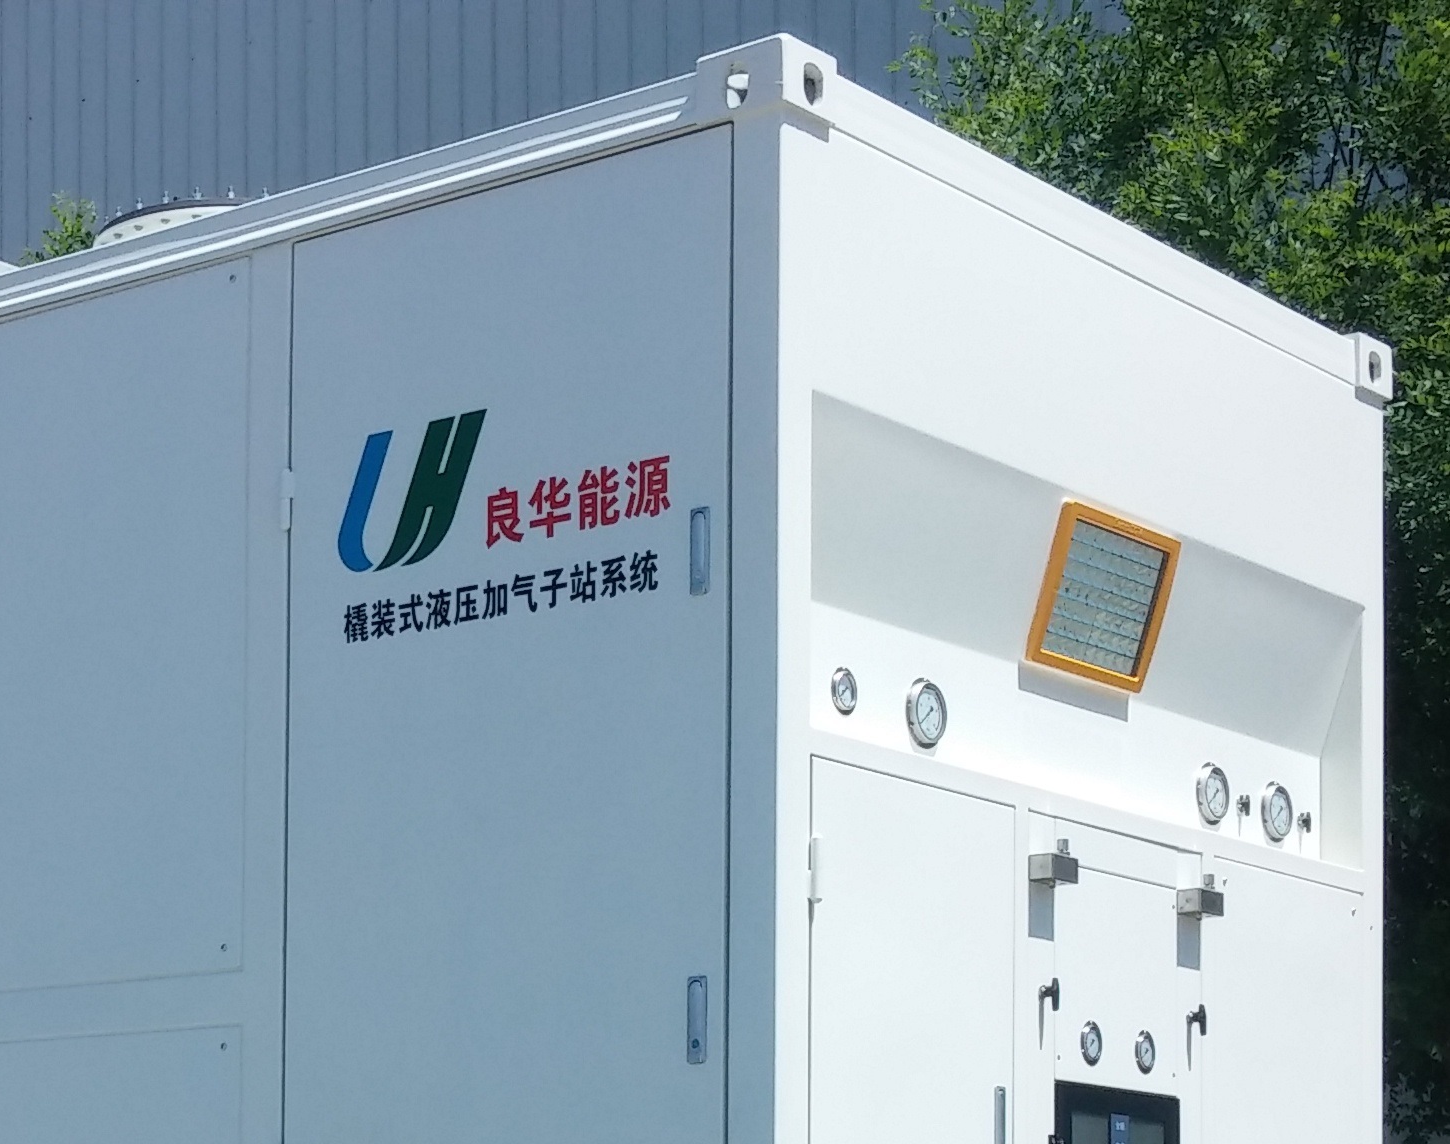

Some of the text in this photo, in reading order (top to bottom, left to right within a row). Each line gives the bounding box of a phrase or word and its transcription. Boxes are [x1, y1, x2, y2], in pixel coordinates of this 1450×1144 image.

[486, 455, 671, 548] 良华能源
[344, 550, 659, 643] 橇装式液压加气子站系统
